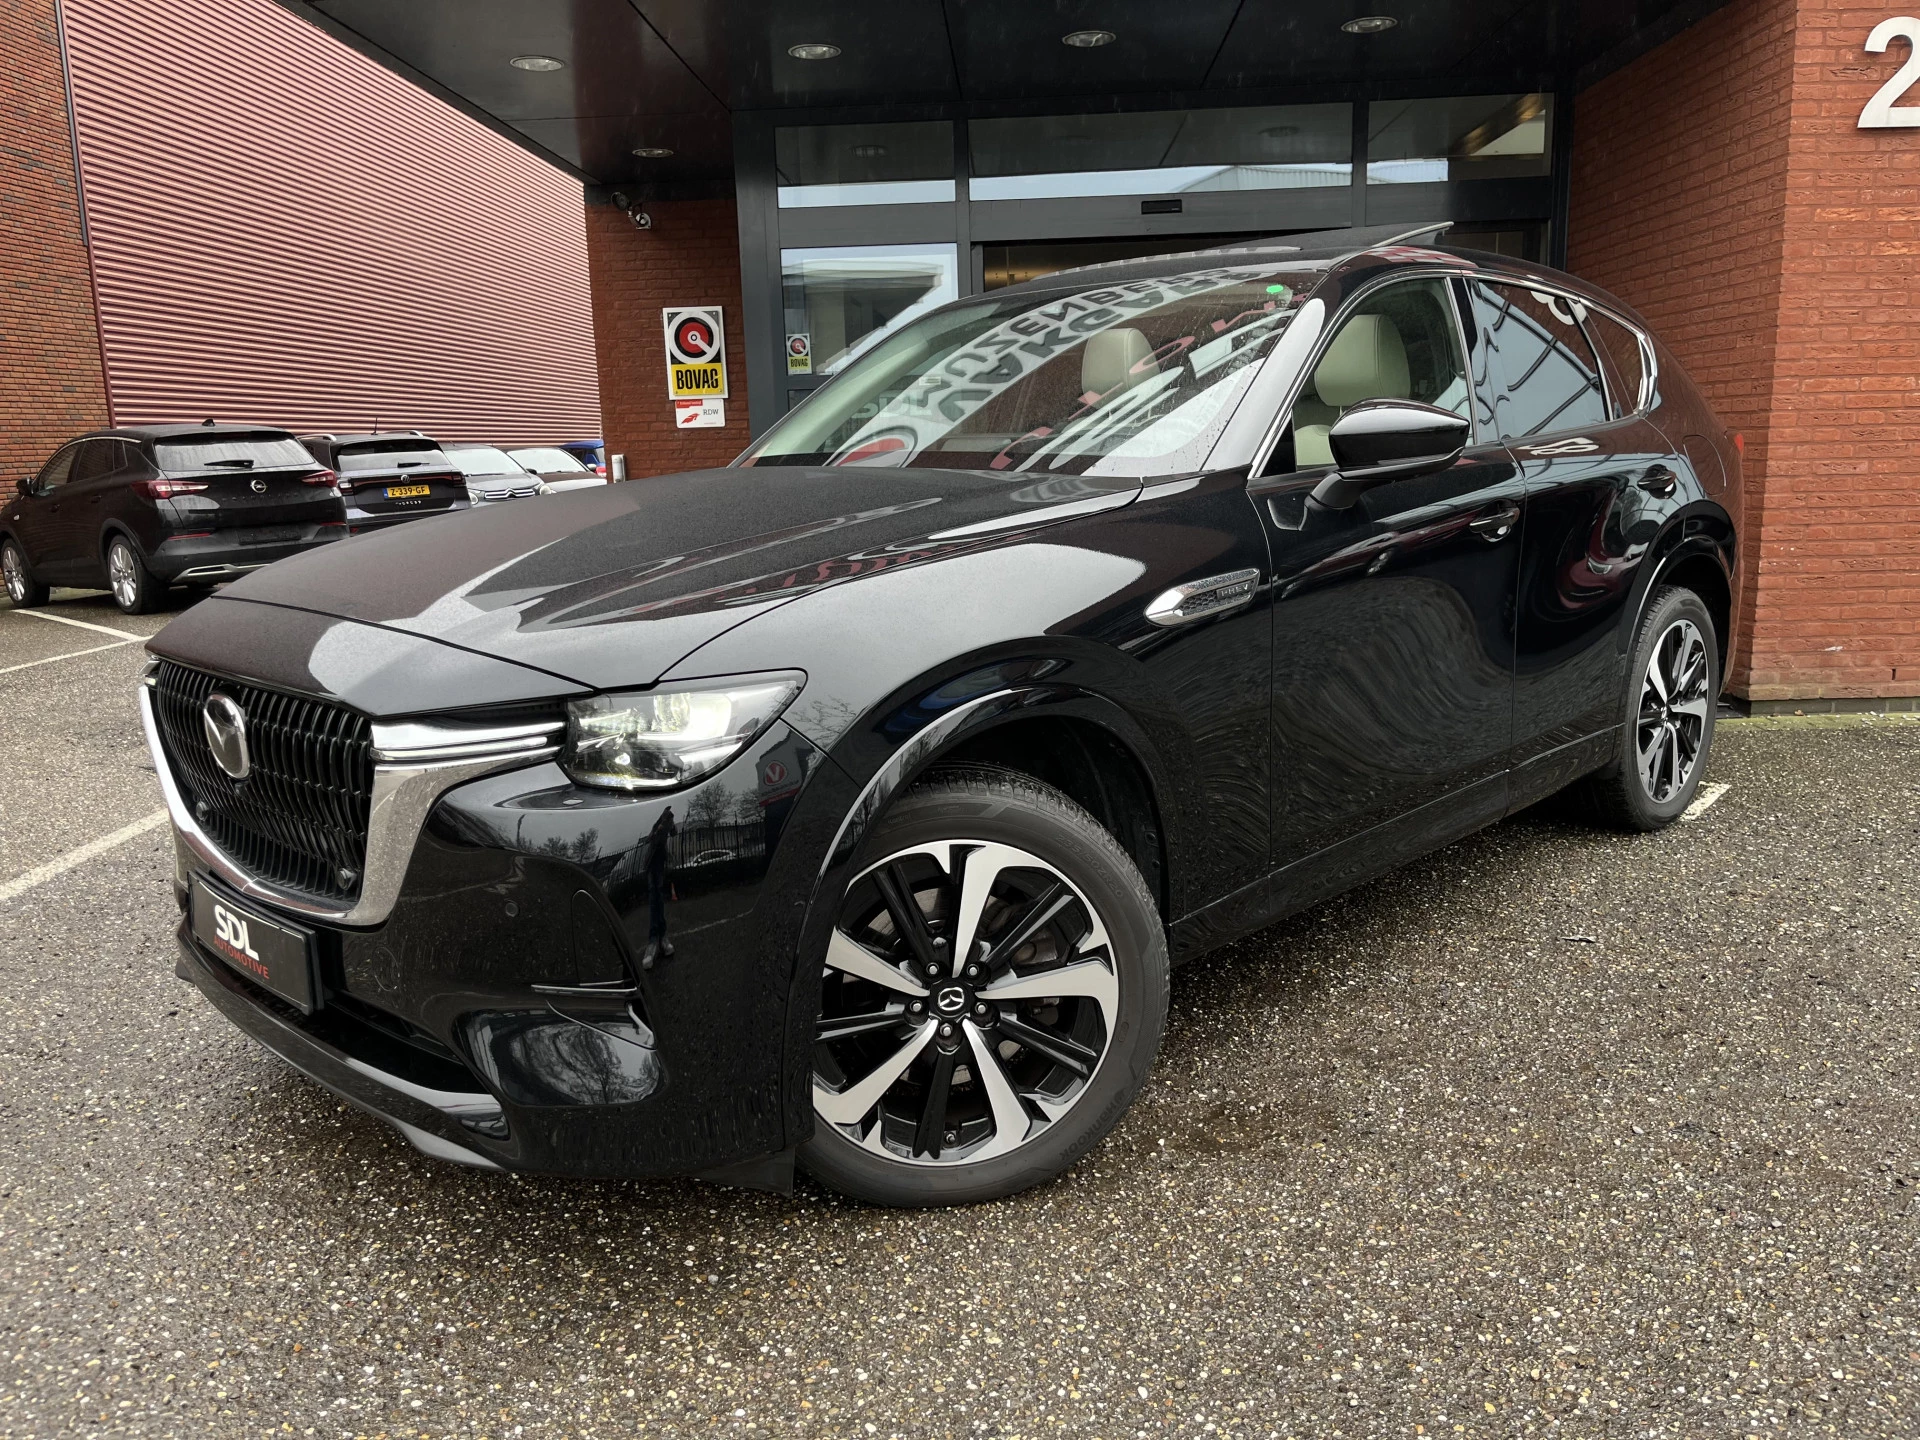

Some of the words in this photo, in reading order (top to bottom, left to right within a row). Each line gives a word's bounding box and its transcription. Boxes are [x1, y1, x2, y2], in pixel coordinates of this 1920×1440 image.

[1857, 16, 1920, 128] 2
[790, 358, 808, 368] BOVAG
[675, 368, 719, 390] BOVAG
[390, 486, 426, 496] Z-339-GF
[1220, 583, 1249, 597] PHEV
[214, 904, 260, 961] SDL
[213, 935, 270, 979] AUTOMOTIVE
